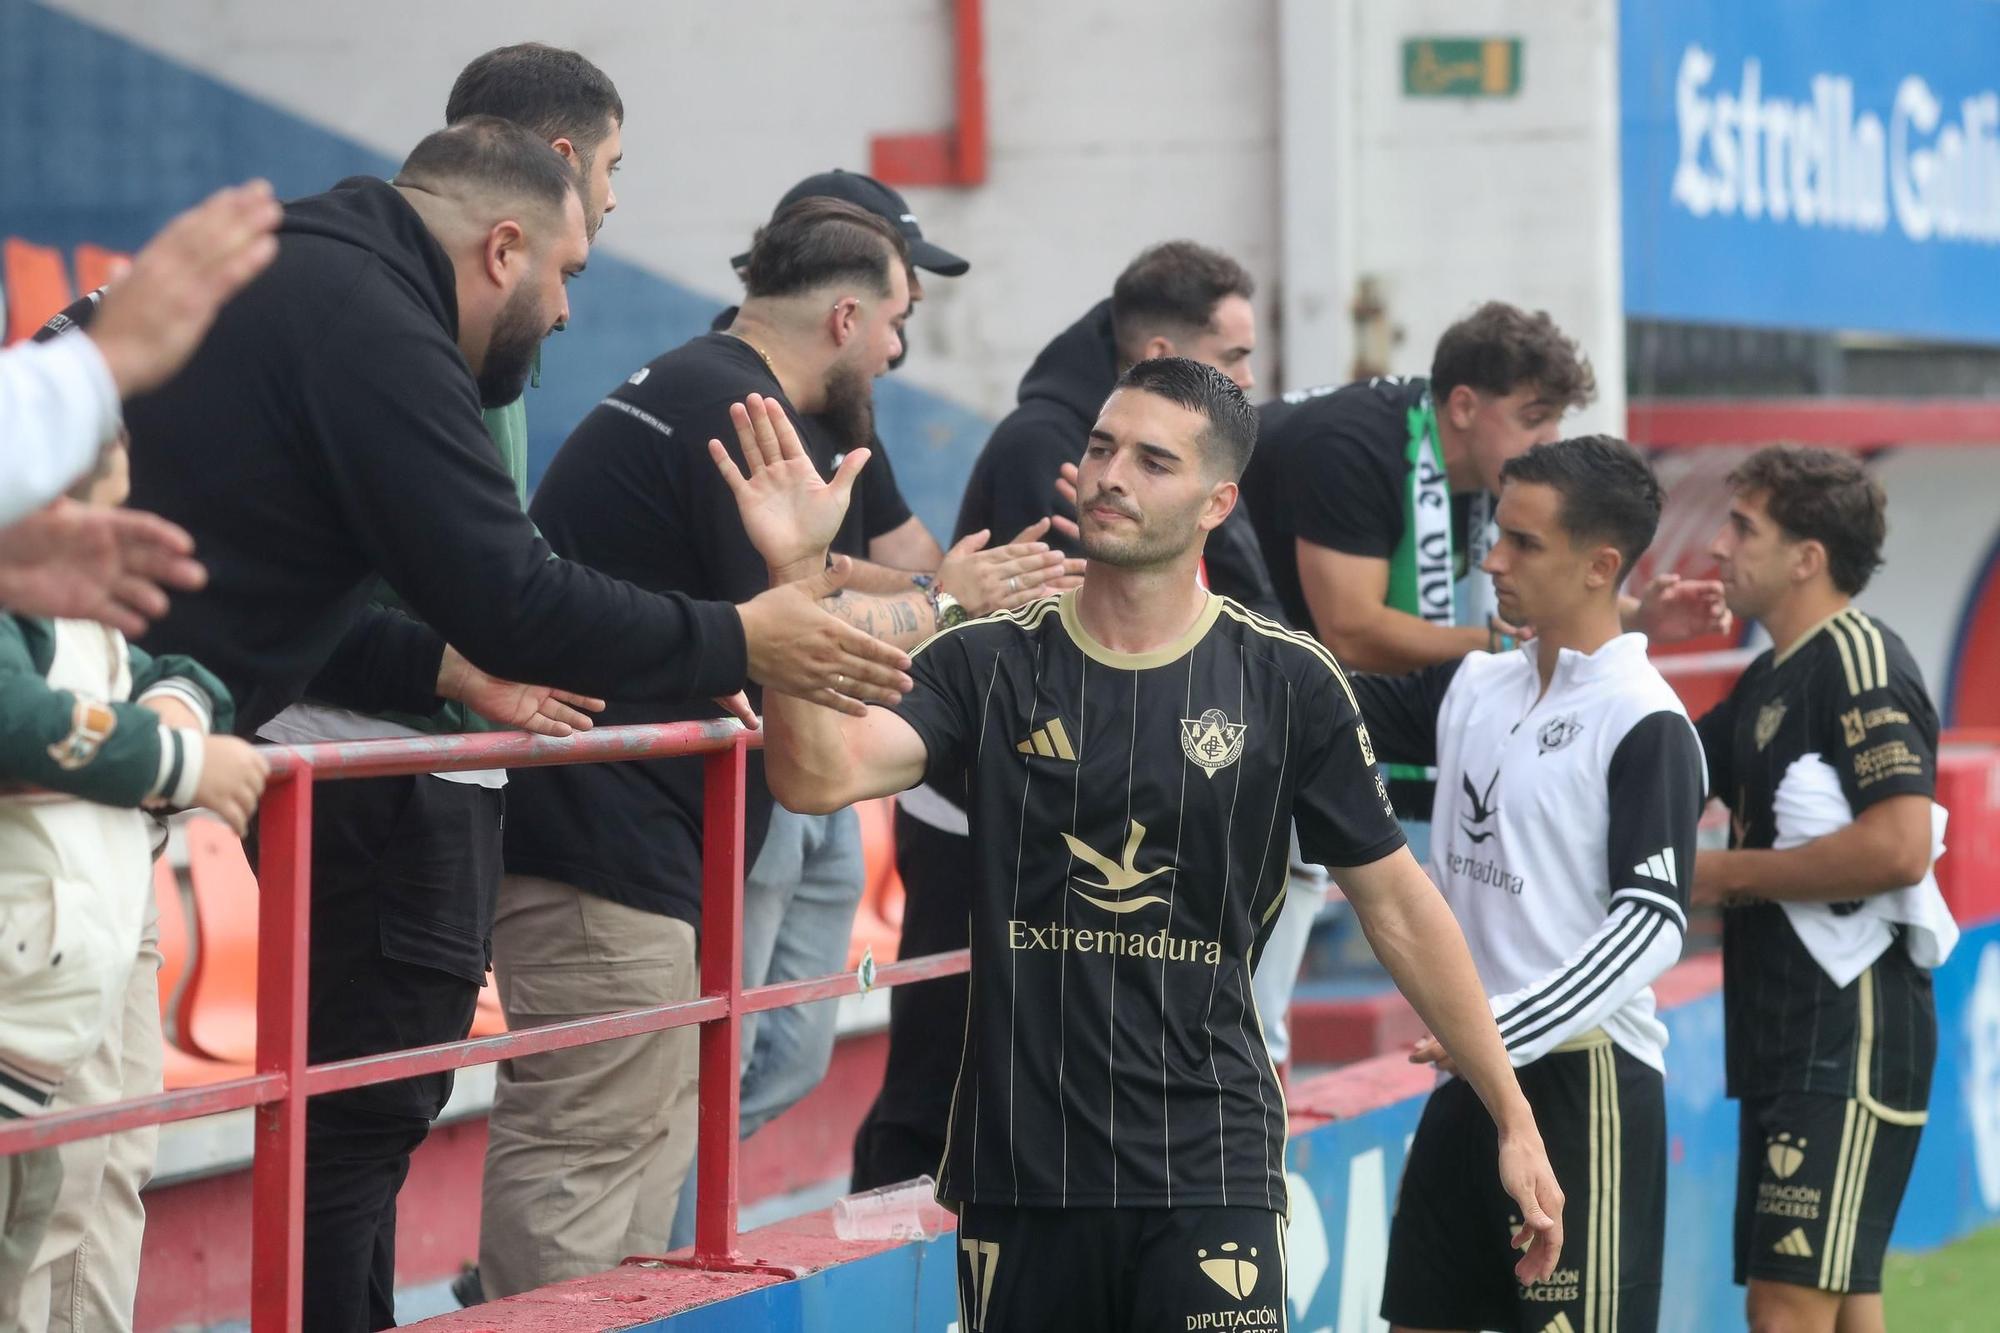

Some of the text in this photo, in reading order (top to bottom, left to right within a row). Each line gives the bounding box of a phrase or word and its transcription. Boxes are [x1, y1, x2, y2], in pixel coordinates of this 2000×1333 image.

[1673, 44, 1888, 234] Estrella
[1008, 920, 1222, 965] Extremadura
[962, 1239, 1000, 1333] 17
[1186, 1305, 1277, 1331] DIPUTACIÓN
